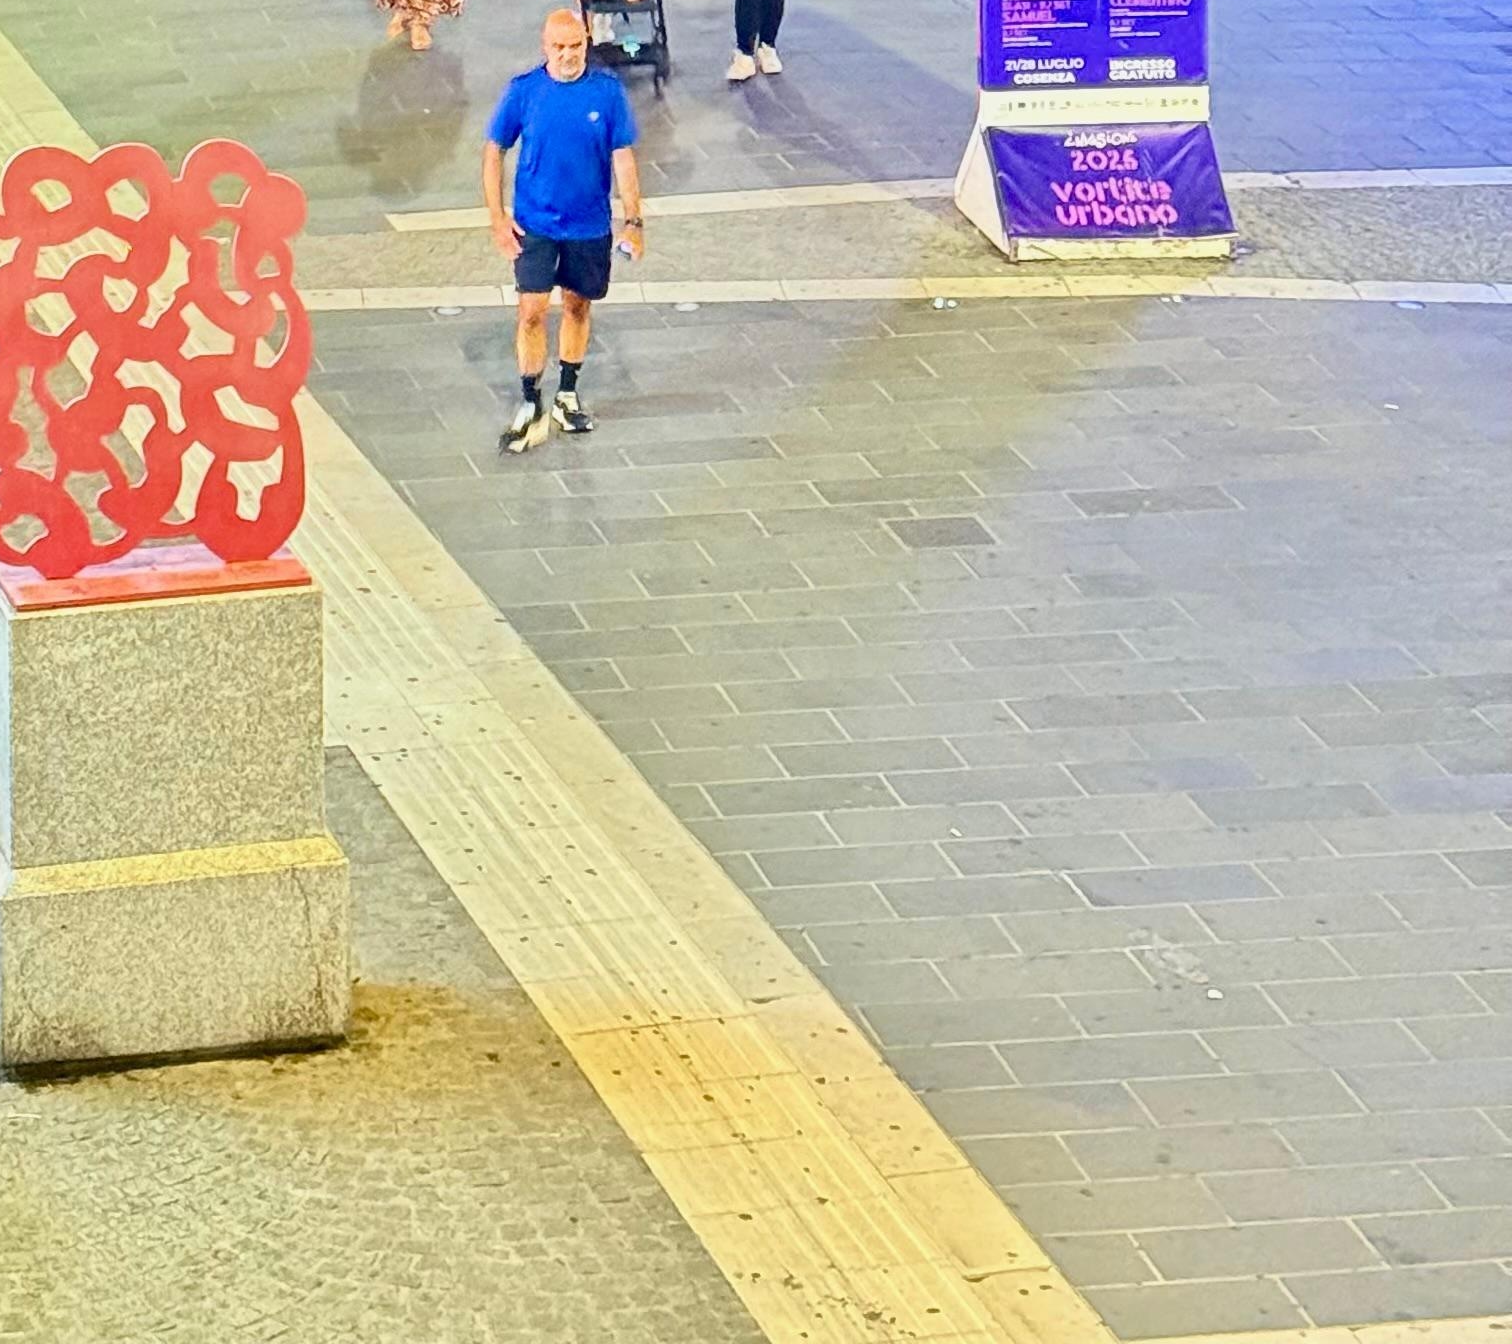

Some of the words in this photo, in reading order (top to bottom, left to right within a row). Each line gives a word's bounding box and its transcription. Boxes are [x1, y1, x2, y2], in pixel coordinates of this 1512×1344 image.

[1038, 57, 1085, 70] LUGLIO
[1013, 72, 1077, 85] COSENZA
[1108, 70, 1177, 81] GRATUITO
[1054, 200, 1179, 228] urbano
